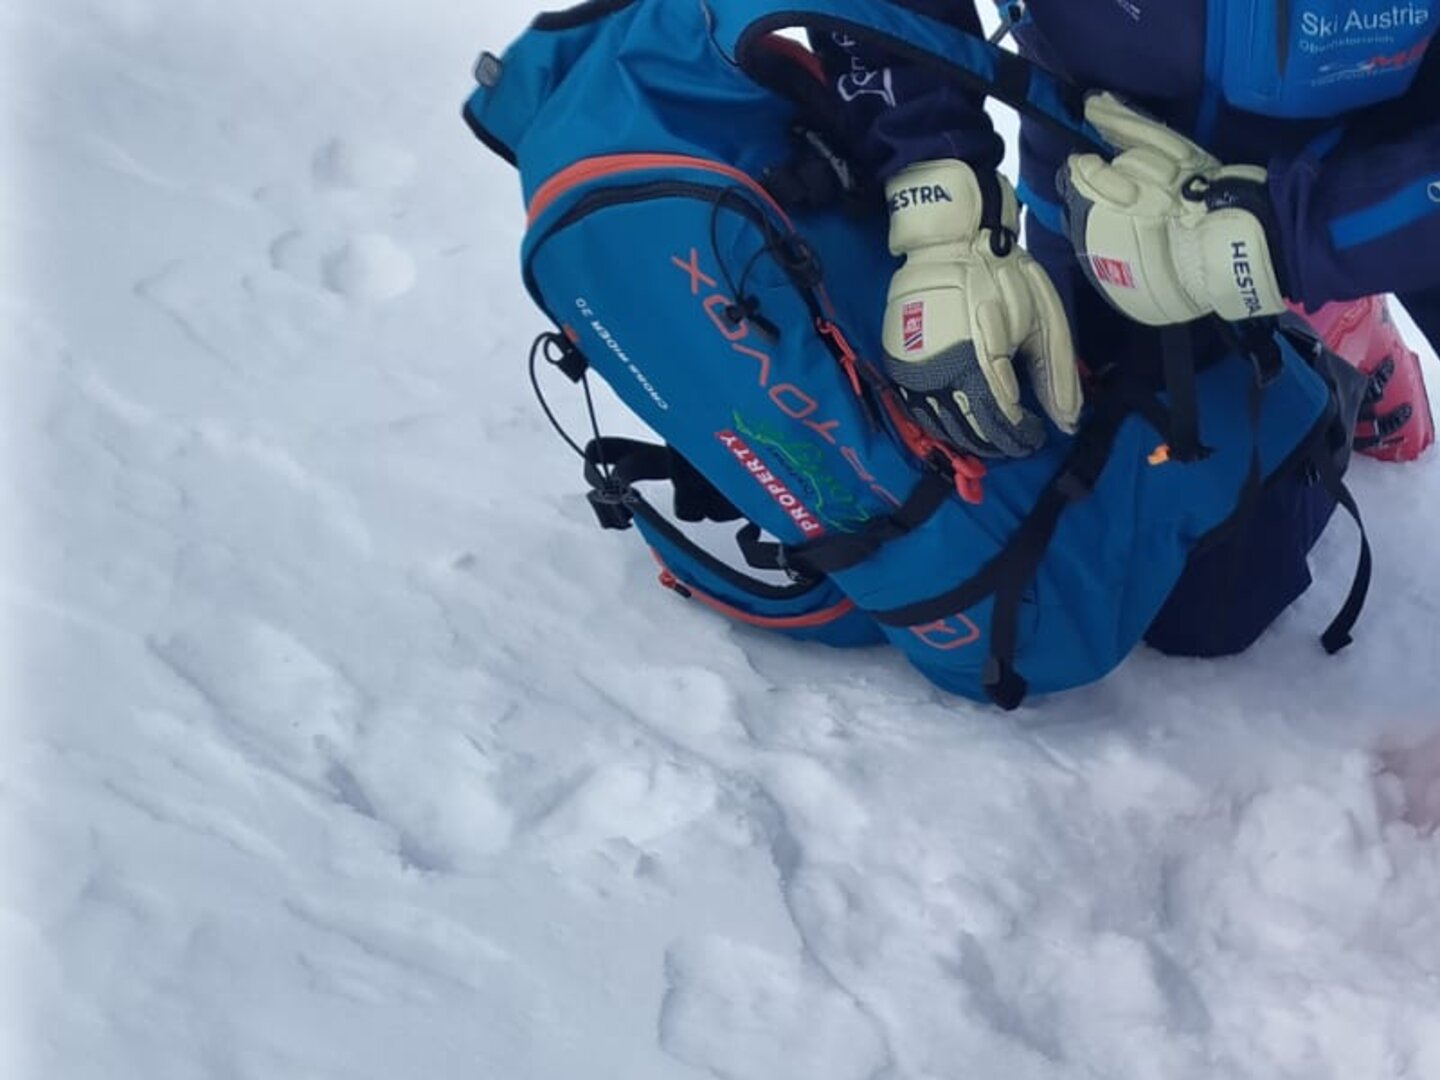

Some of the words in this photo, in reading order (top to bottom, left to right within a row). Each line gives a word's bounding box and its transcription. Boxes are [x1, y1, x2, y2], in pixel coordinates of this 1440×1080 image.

[1301, 11, 1338, 37] Ski
[1344, 2, 1429, 33] Austria
[889, 182, 953, 216] ESTRA
[1231, 241, 1262, 316] HESTRA
[575, 297, 594, 318] 20
[590, 319, 630, 363] RIDER
[628, 363, 669, 410] CROSS
[719, 433, 820, 532] PROPERTY
